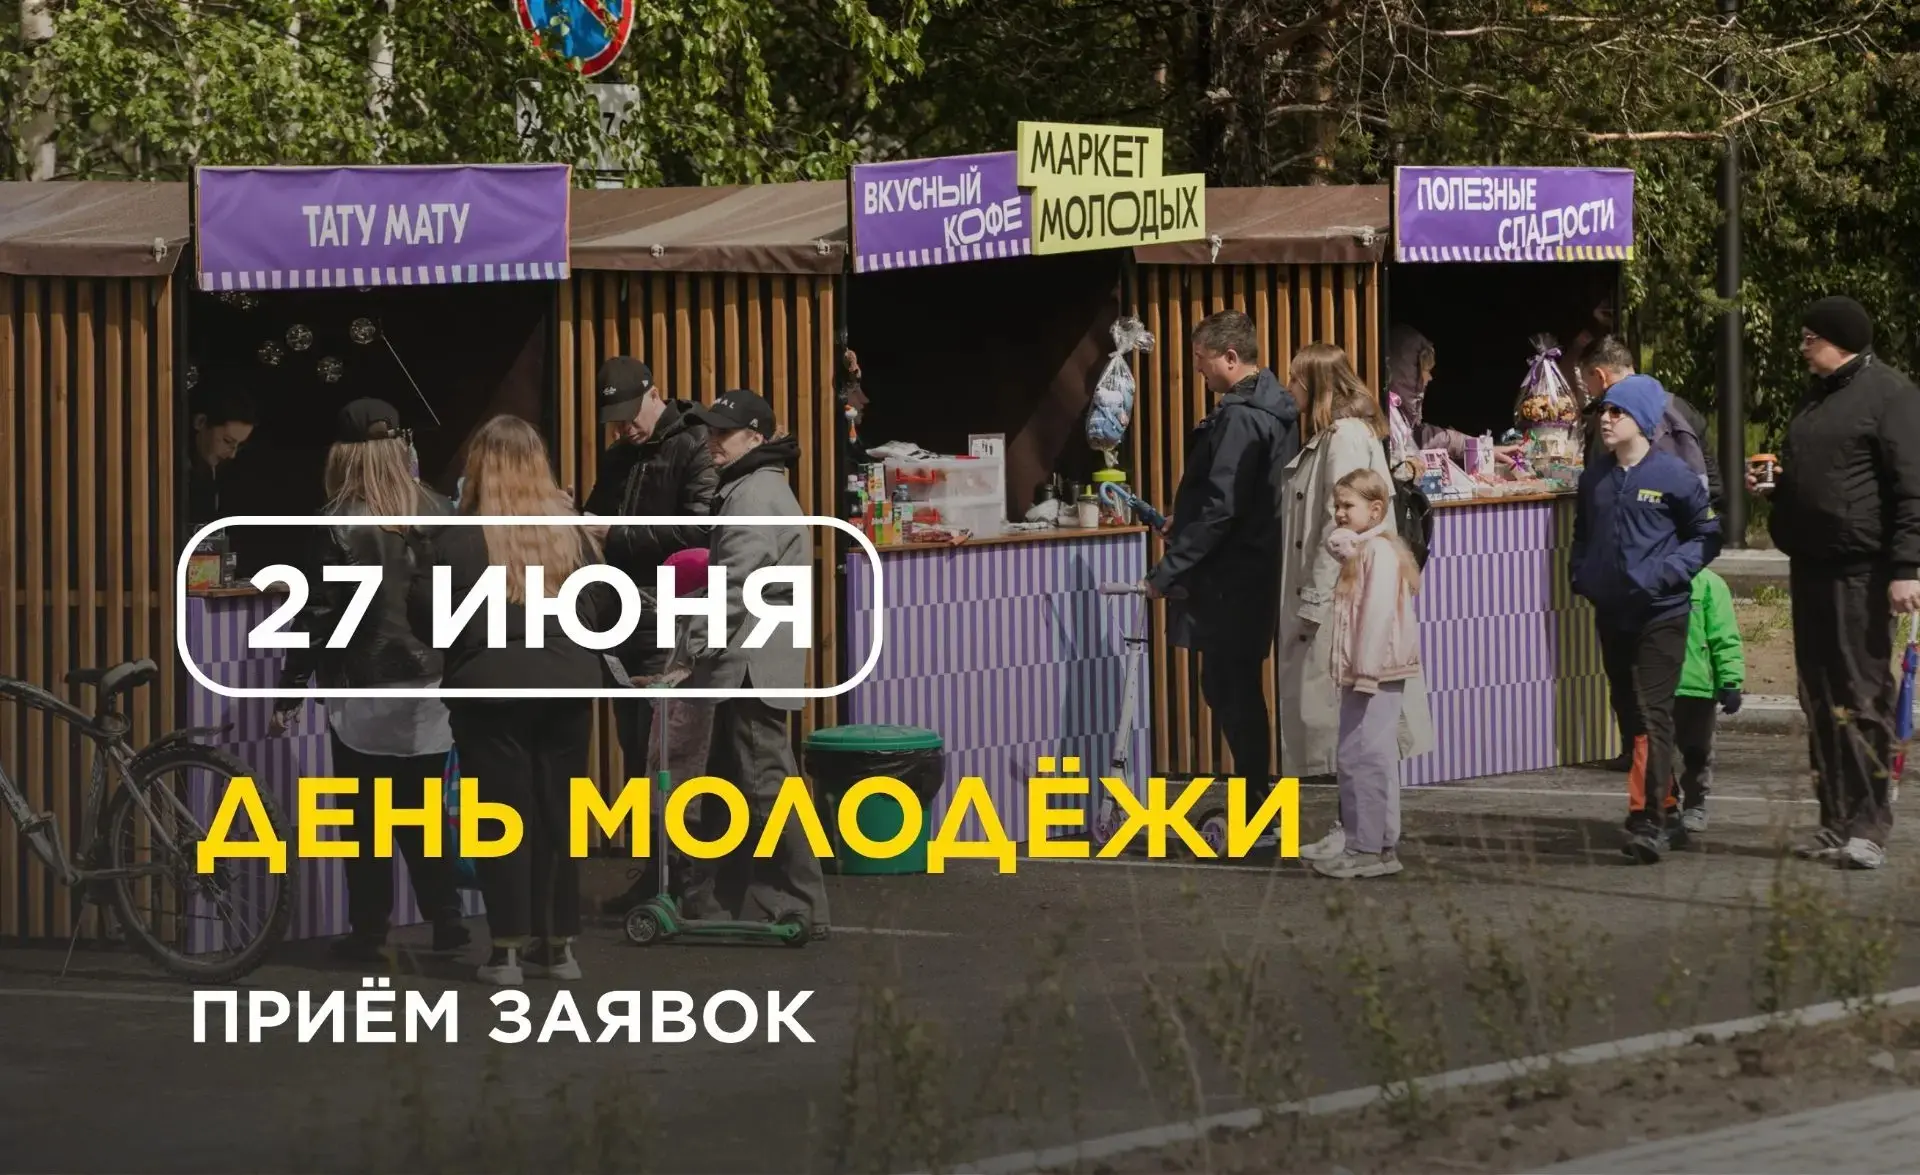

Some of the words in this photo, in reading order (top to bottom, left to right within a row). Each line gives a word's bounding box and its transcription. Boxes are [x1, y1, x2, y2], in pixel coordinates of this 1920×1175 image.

[1030, 129, 1149, 178] МАРКЕТ
[864, 165, 981, 214] ВКУСНЫЙ
[1039, 185, 1199, 242] МОЛОДЫХ
[1418, 176, 1537, 211] ПОЛЕЗНЫЕ
[303, 204, 377, 247] ТАТУ
[384, 203, 470, 246] МАТУ
[944, 195, 1023, 248] КОФЕ
[1498, 197, 1615, 251] СЛАДОСТИ
